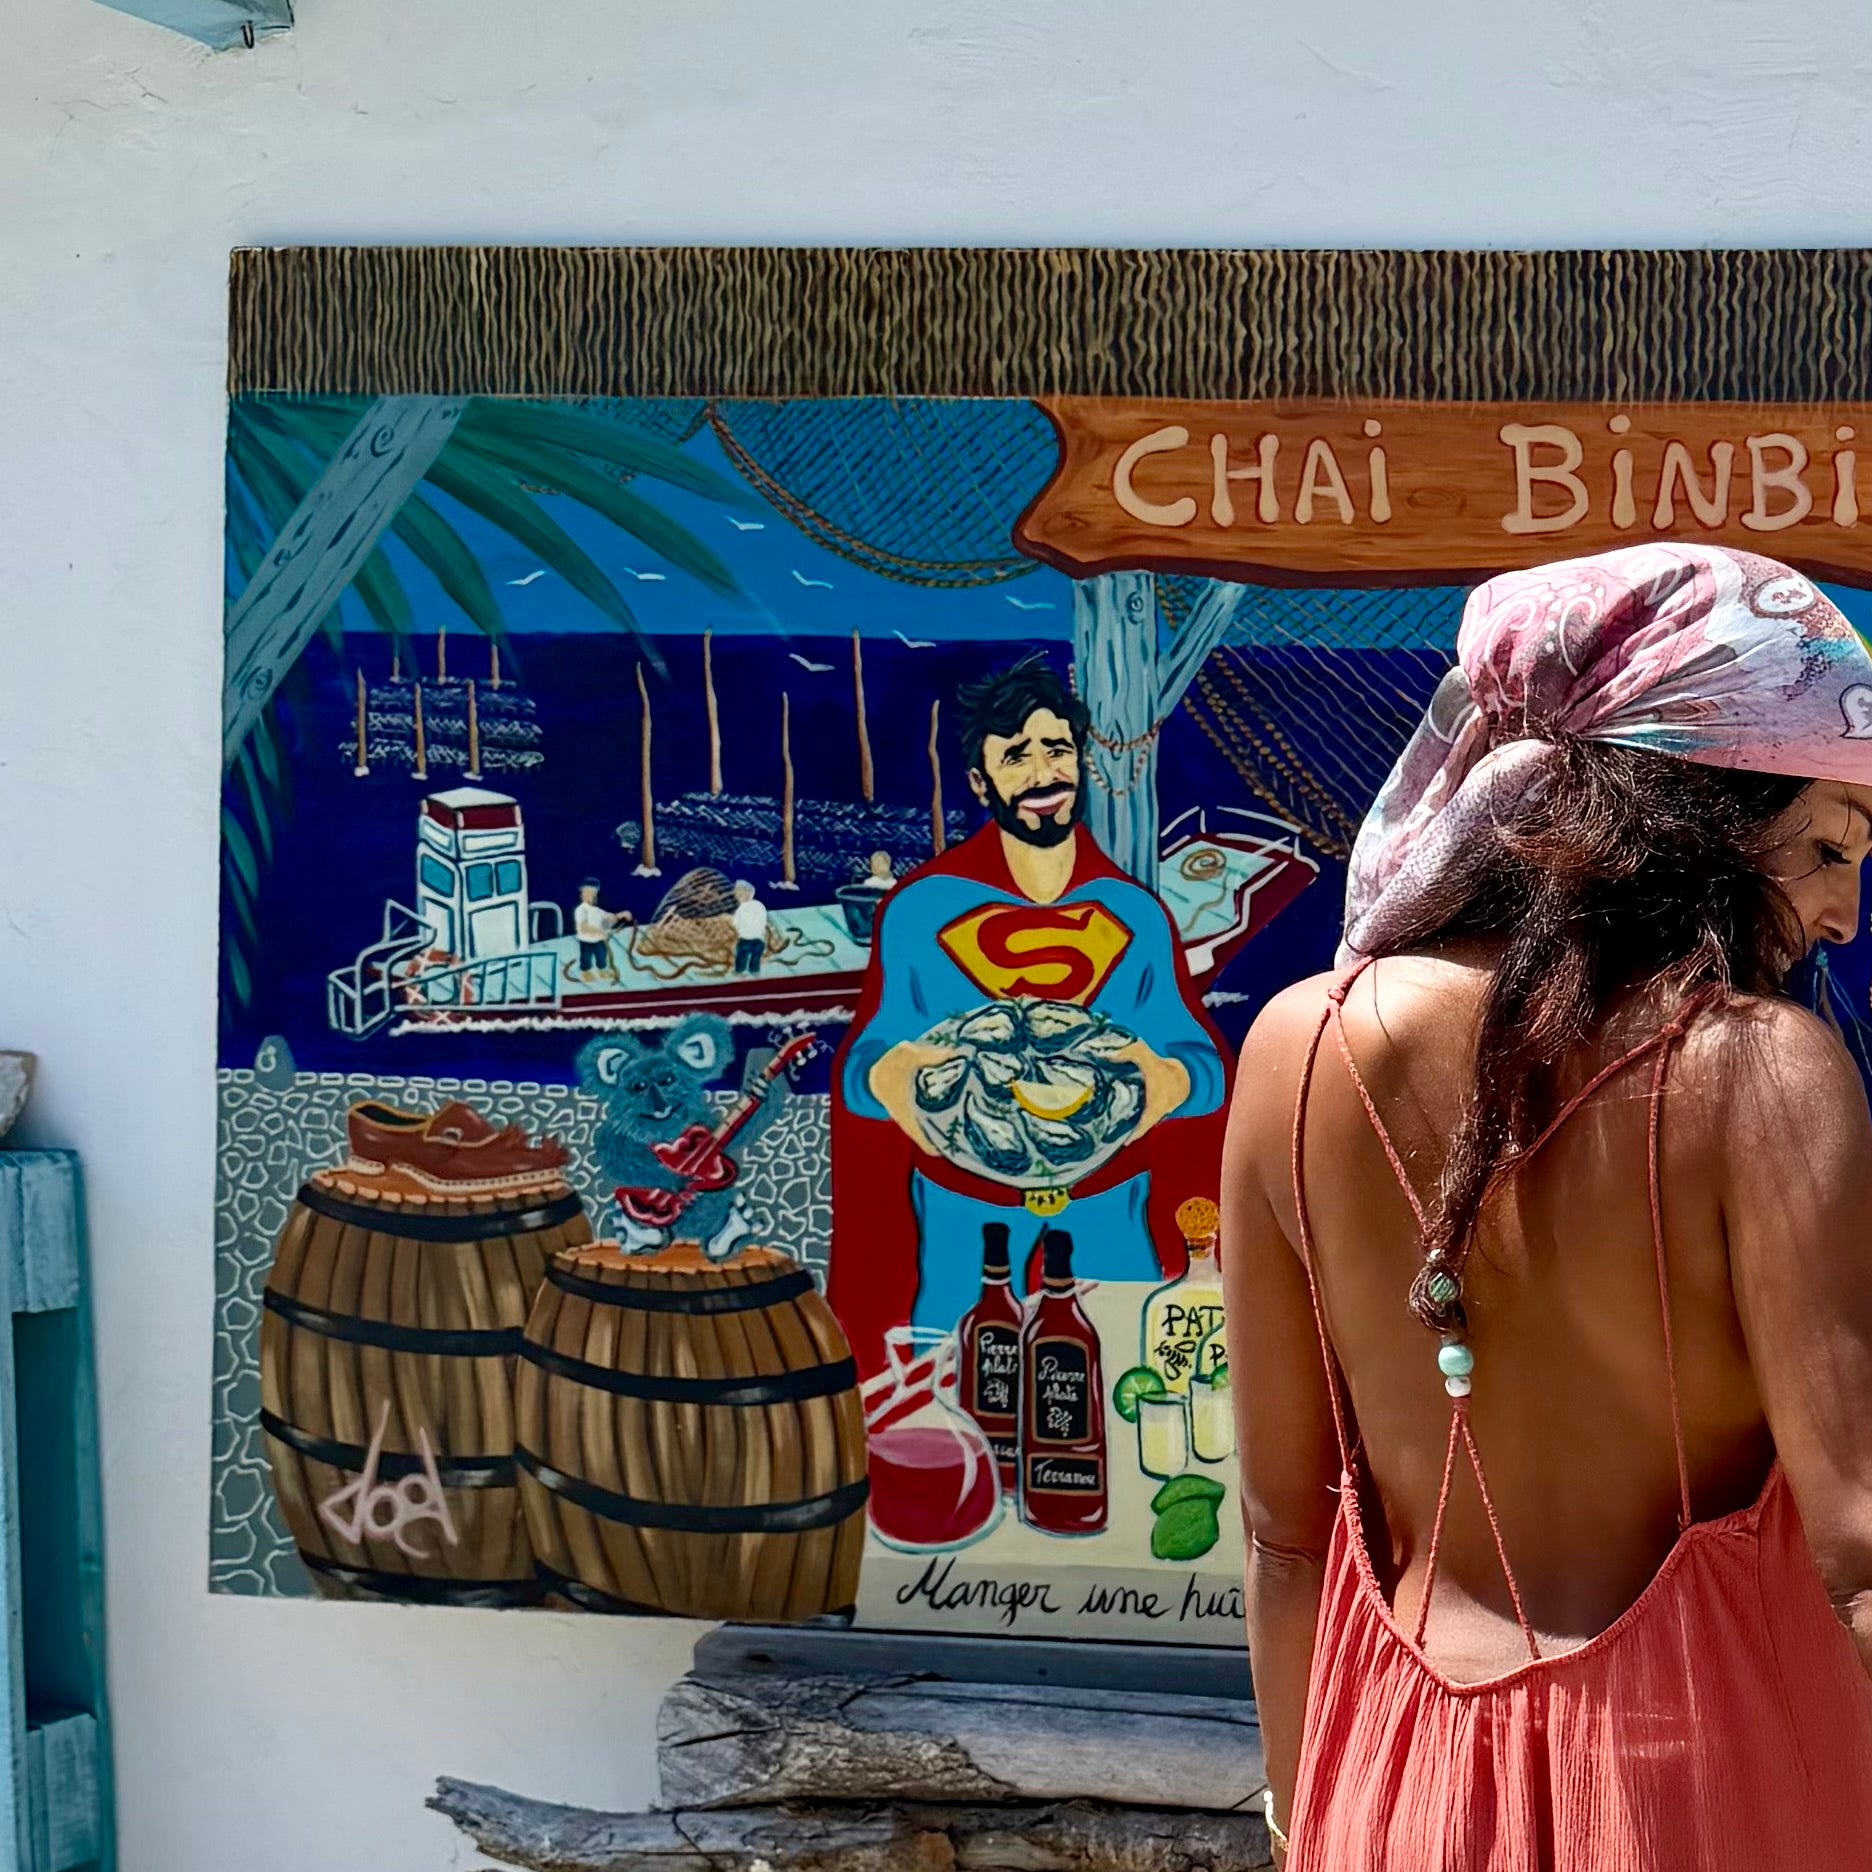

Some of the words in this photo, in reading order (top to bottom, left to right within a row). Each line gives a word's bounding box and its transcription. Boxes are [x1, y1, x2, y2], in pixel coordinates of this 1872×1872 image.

[1161, 1304, 1225, 1337] PAT
[896, 1556, 1062, 1628] Manger
[1077, 1583, 1173, 1619] une
[1179, 1572, 1247, 1622] huî
